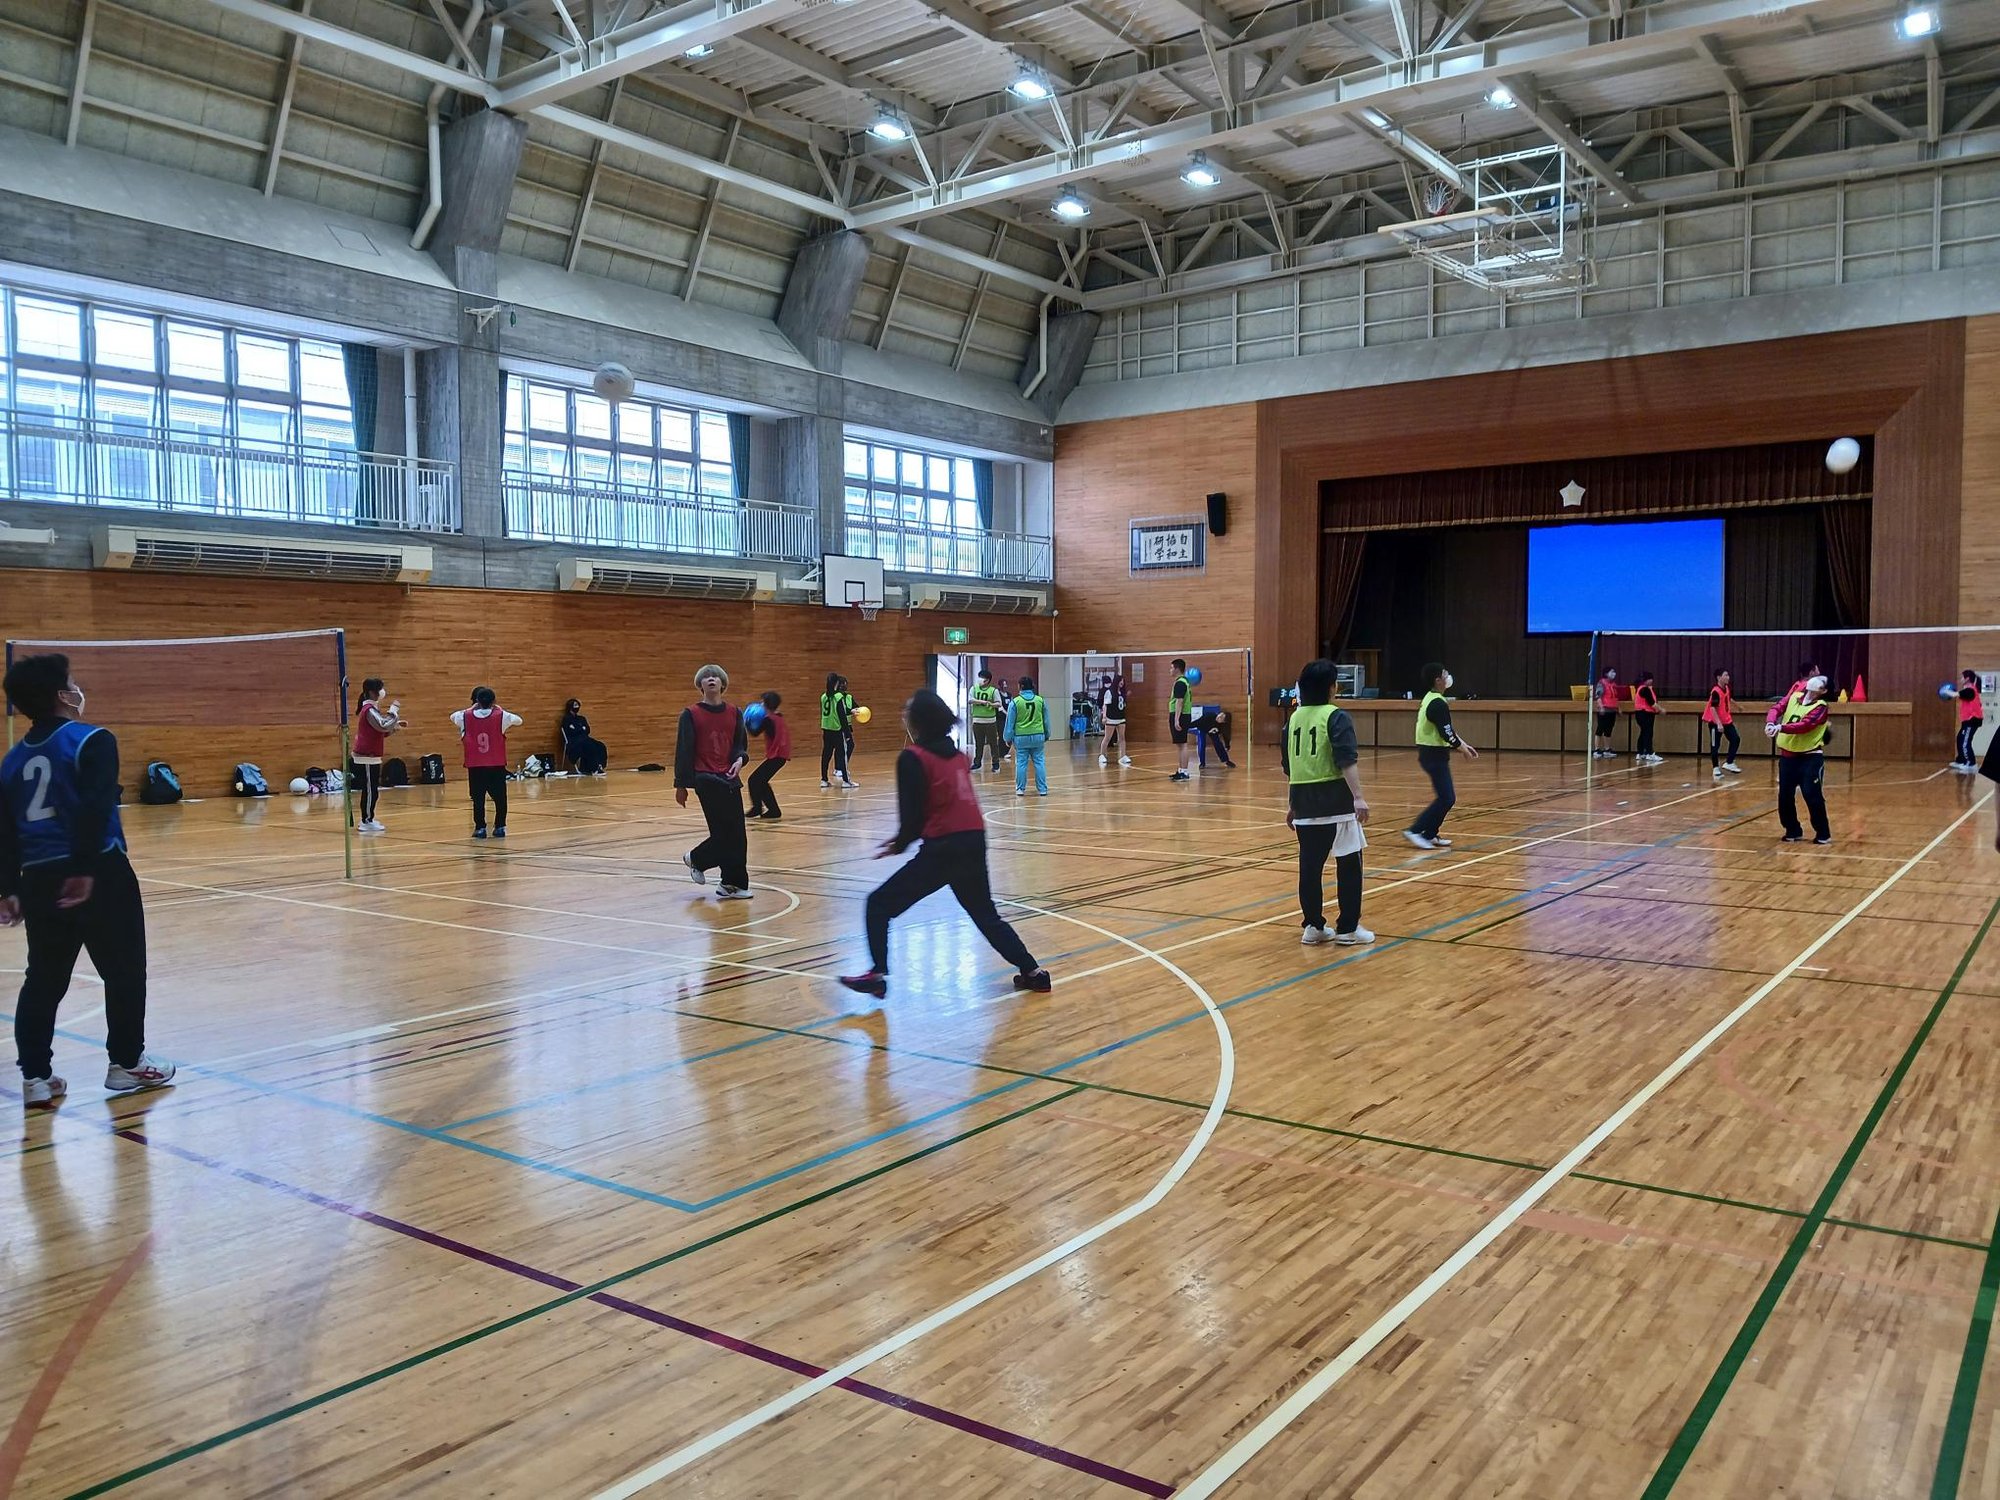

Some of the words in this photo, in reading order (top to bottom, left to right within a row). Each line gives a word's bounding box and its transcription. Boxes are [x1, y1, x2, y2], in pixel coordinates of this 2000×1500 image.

[823, 698, 831, 716] 9
[1025, 702, 1036, 722] 7
[1118, 696, 1124, 710] 8
[477, 732, 489, 753] 9
[1293, 726, 1317, 756] 11
[22, 755, 56, 822] 2
